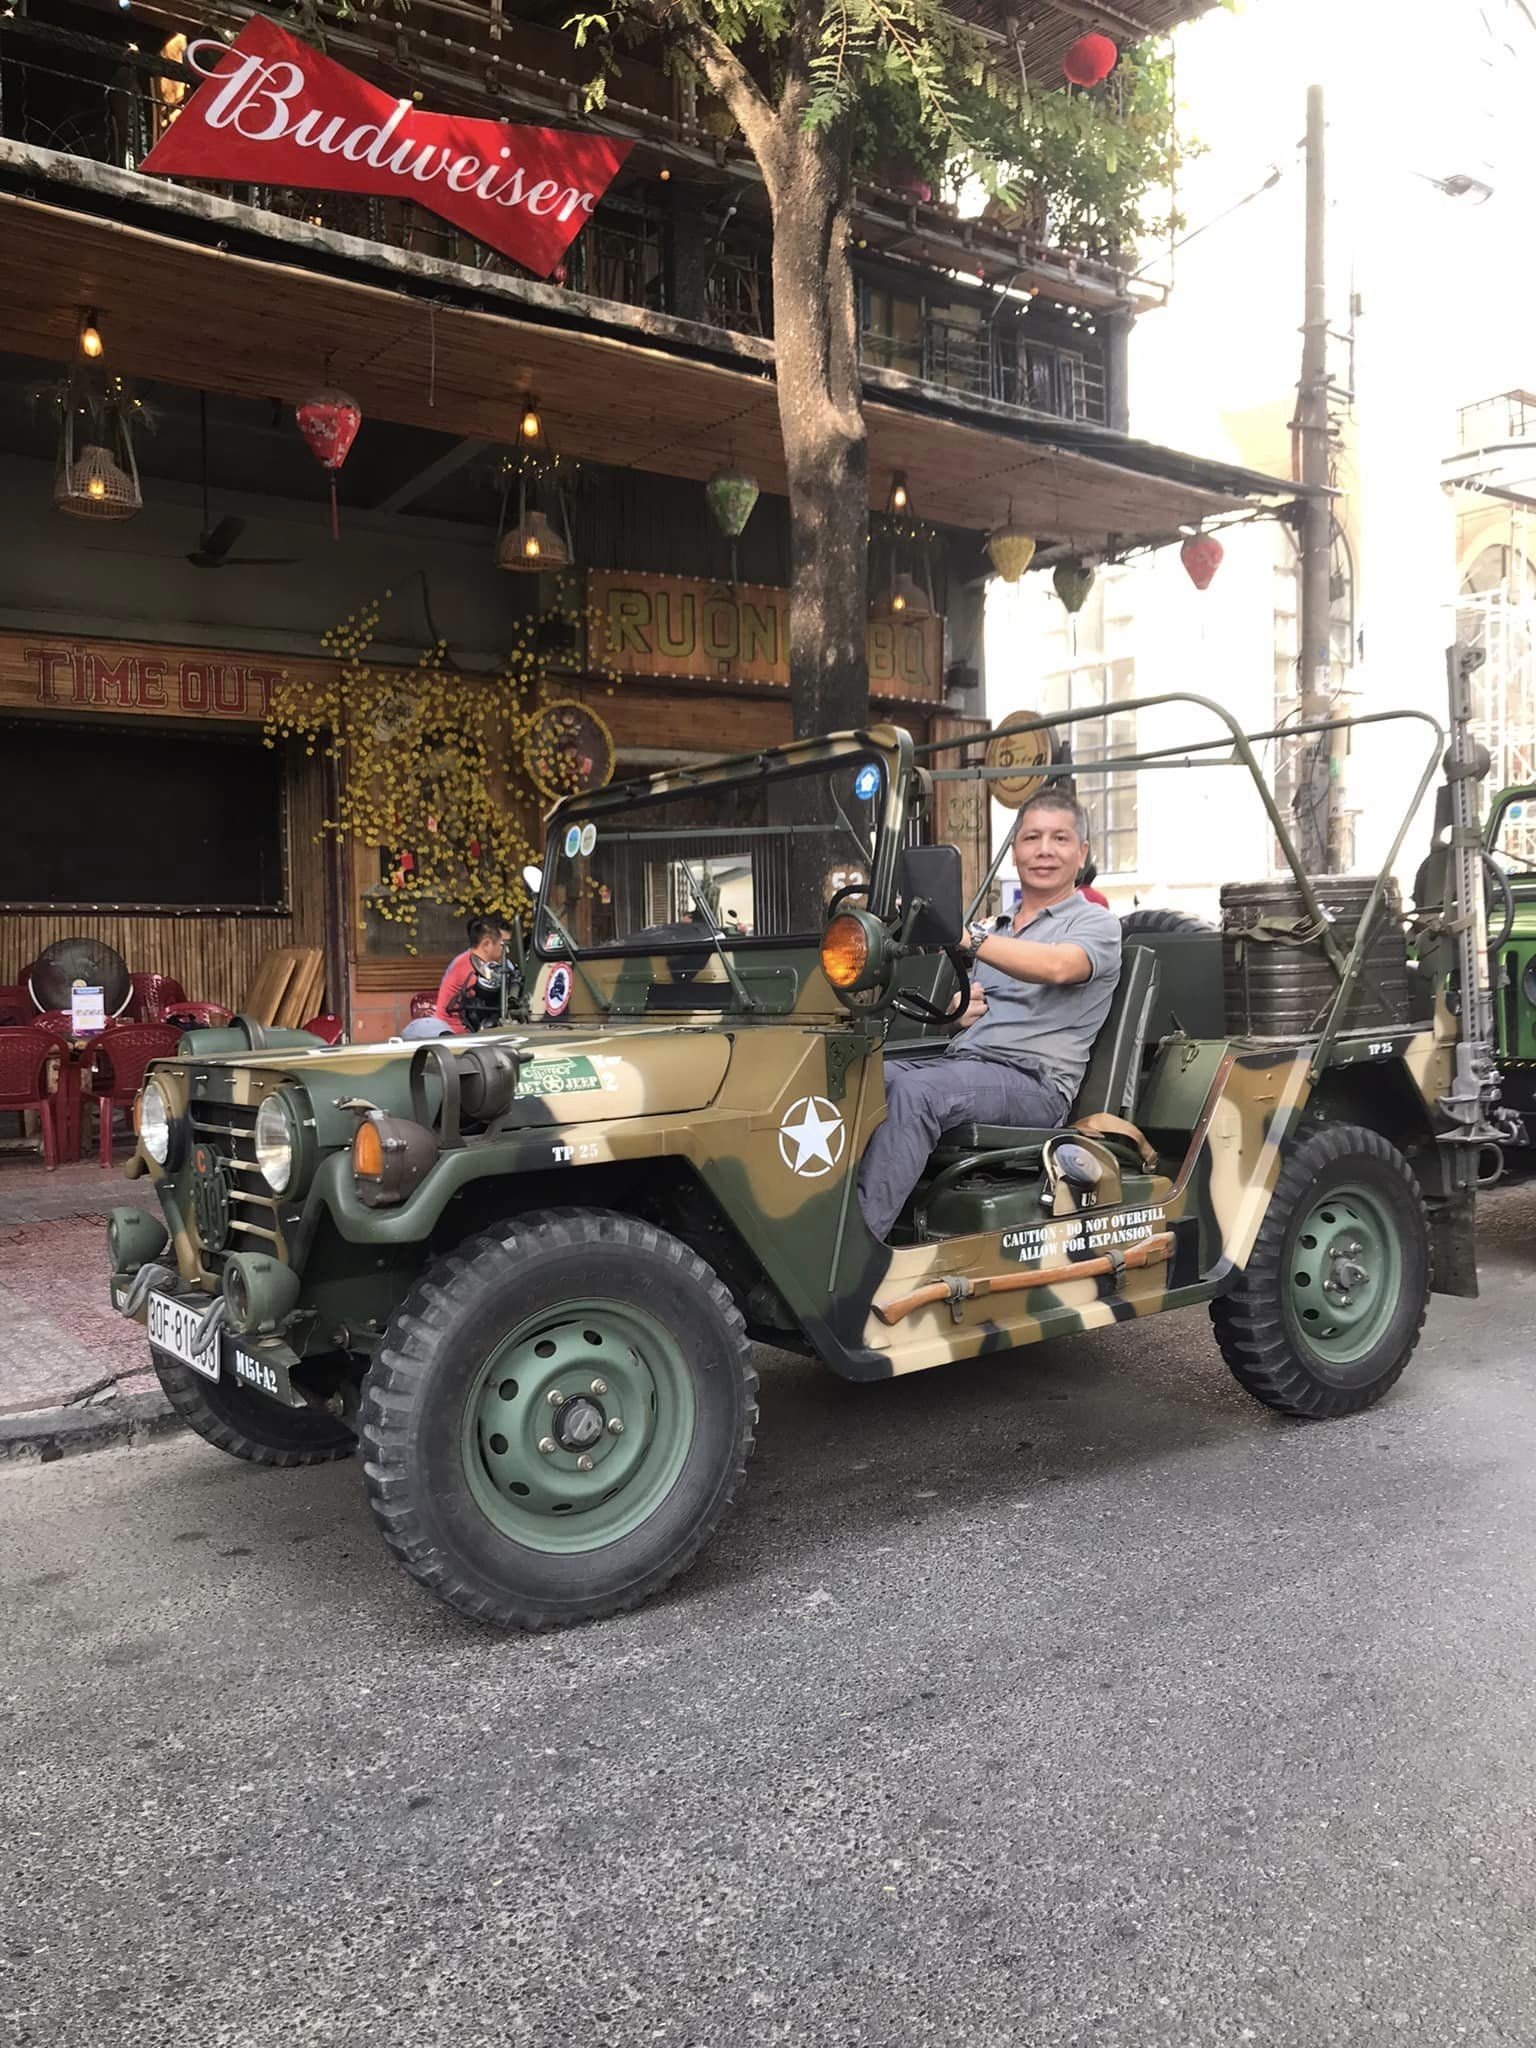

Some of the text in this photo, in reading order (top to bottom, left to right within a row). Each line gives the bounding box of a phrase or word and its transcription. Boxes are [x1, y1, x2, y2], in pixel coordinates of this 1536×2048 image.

[186, 39, 594, 221] Budweiser
[608, 584, 790, 675] RUỘN
[179, 661, 286, 717] OUT
[1368, 1043, 1380, 1055] TP
[565, 1075, 598, 1091] JEEP
[552, 1143, 598, 1162] TP 25
[1081, 1192, 1097, 1207] US
[1003, 1226, 1057, 1248] CAUTION
[1066, 1223, 1083, 1237] DO
[1085, 1217, 1110, 1233] NOT
[1111, 1207, 1166, 1227] OVERFILL
[1018, 1225, 1153, 1262] ALLOW FOR EXPANSION
